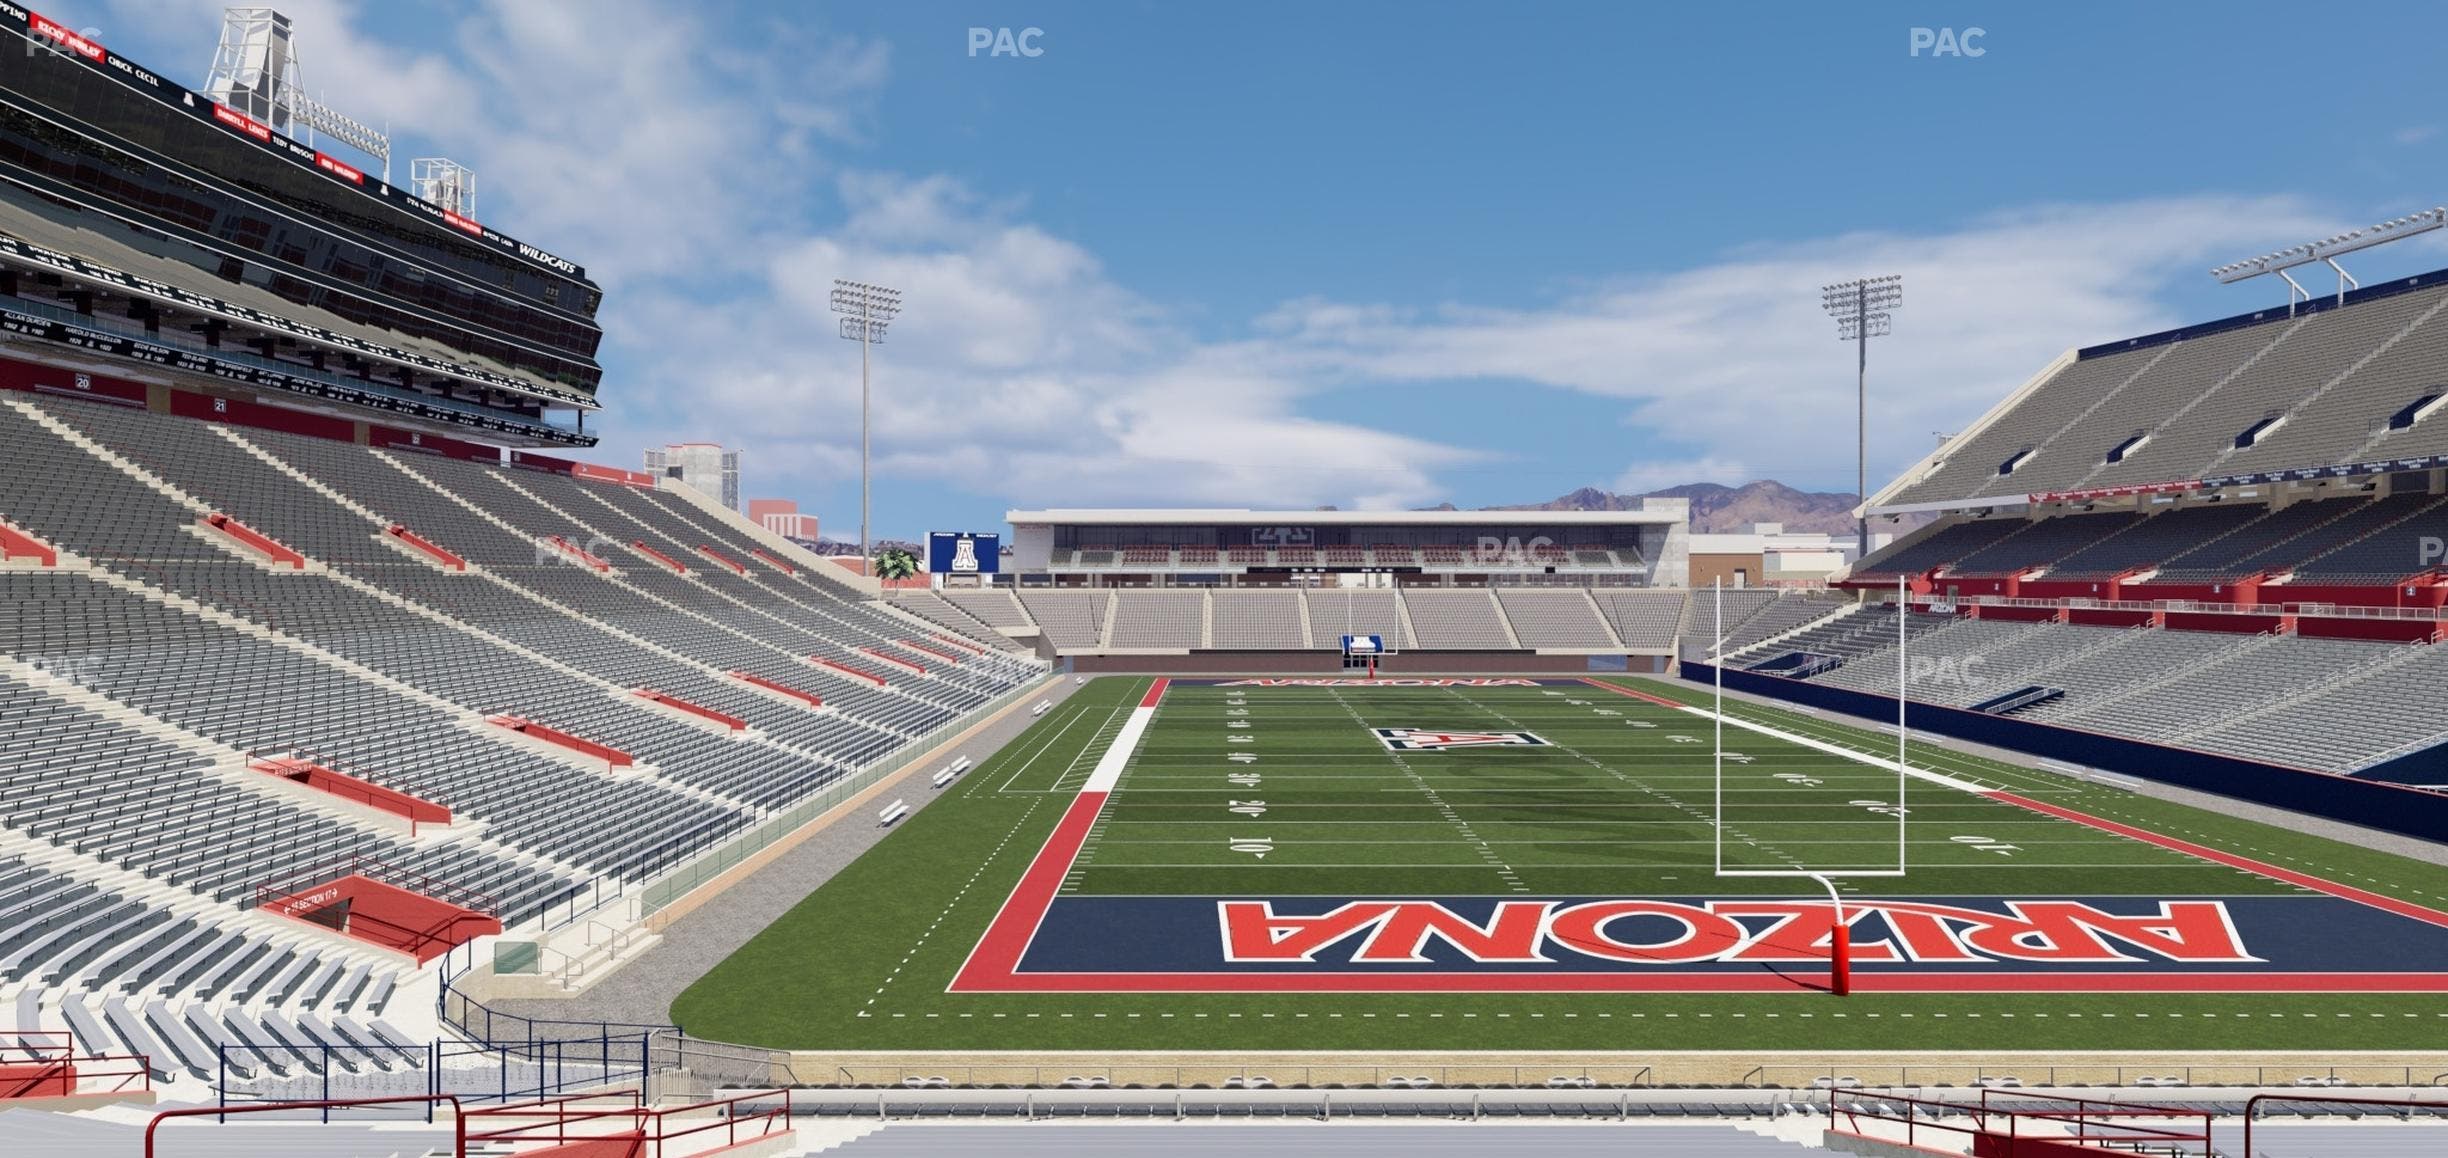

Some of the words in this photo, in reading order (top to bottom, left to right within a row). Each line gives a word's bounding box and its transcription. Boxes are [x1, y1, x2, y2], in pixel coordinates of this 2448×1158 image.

[108, 56, 133, 74] CHUCK
[135, 69, 159, 87] CECIL
[519, 243, 576, 274] WILDCATS
[77, 378, 89, 389] 20
[215, 402, 225, 412] 21
[1229, 800, 1267, 813] 20
[1230, 837, 1274, 852] 10
[1949, 836, 2024, 851] 10
[1217, 901, 2271, 962] ARIZONA
